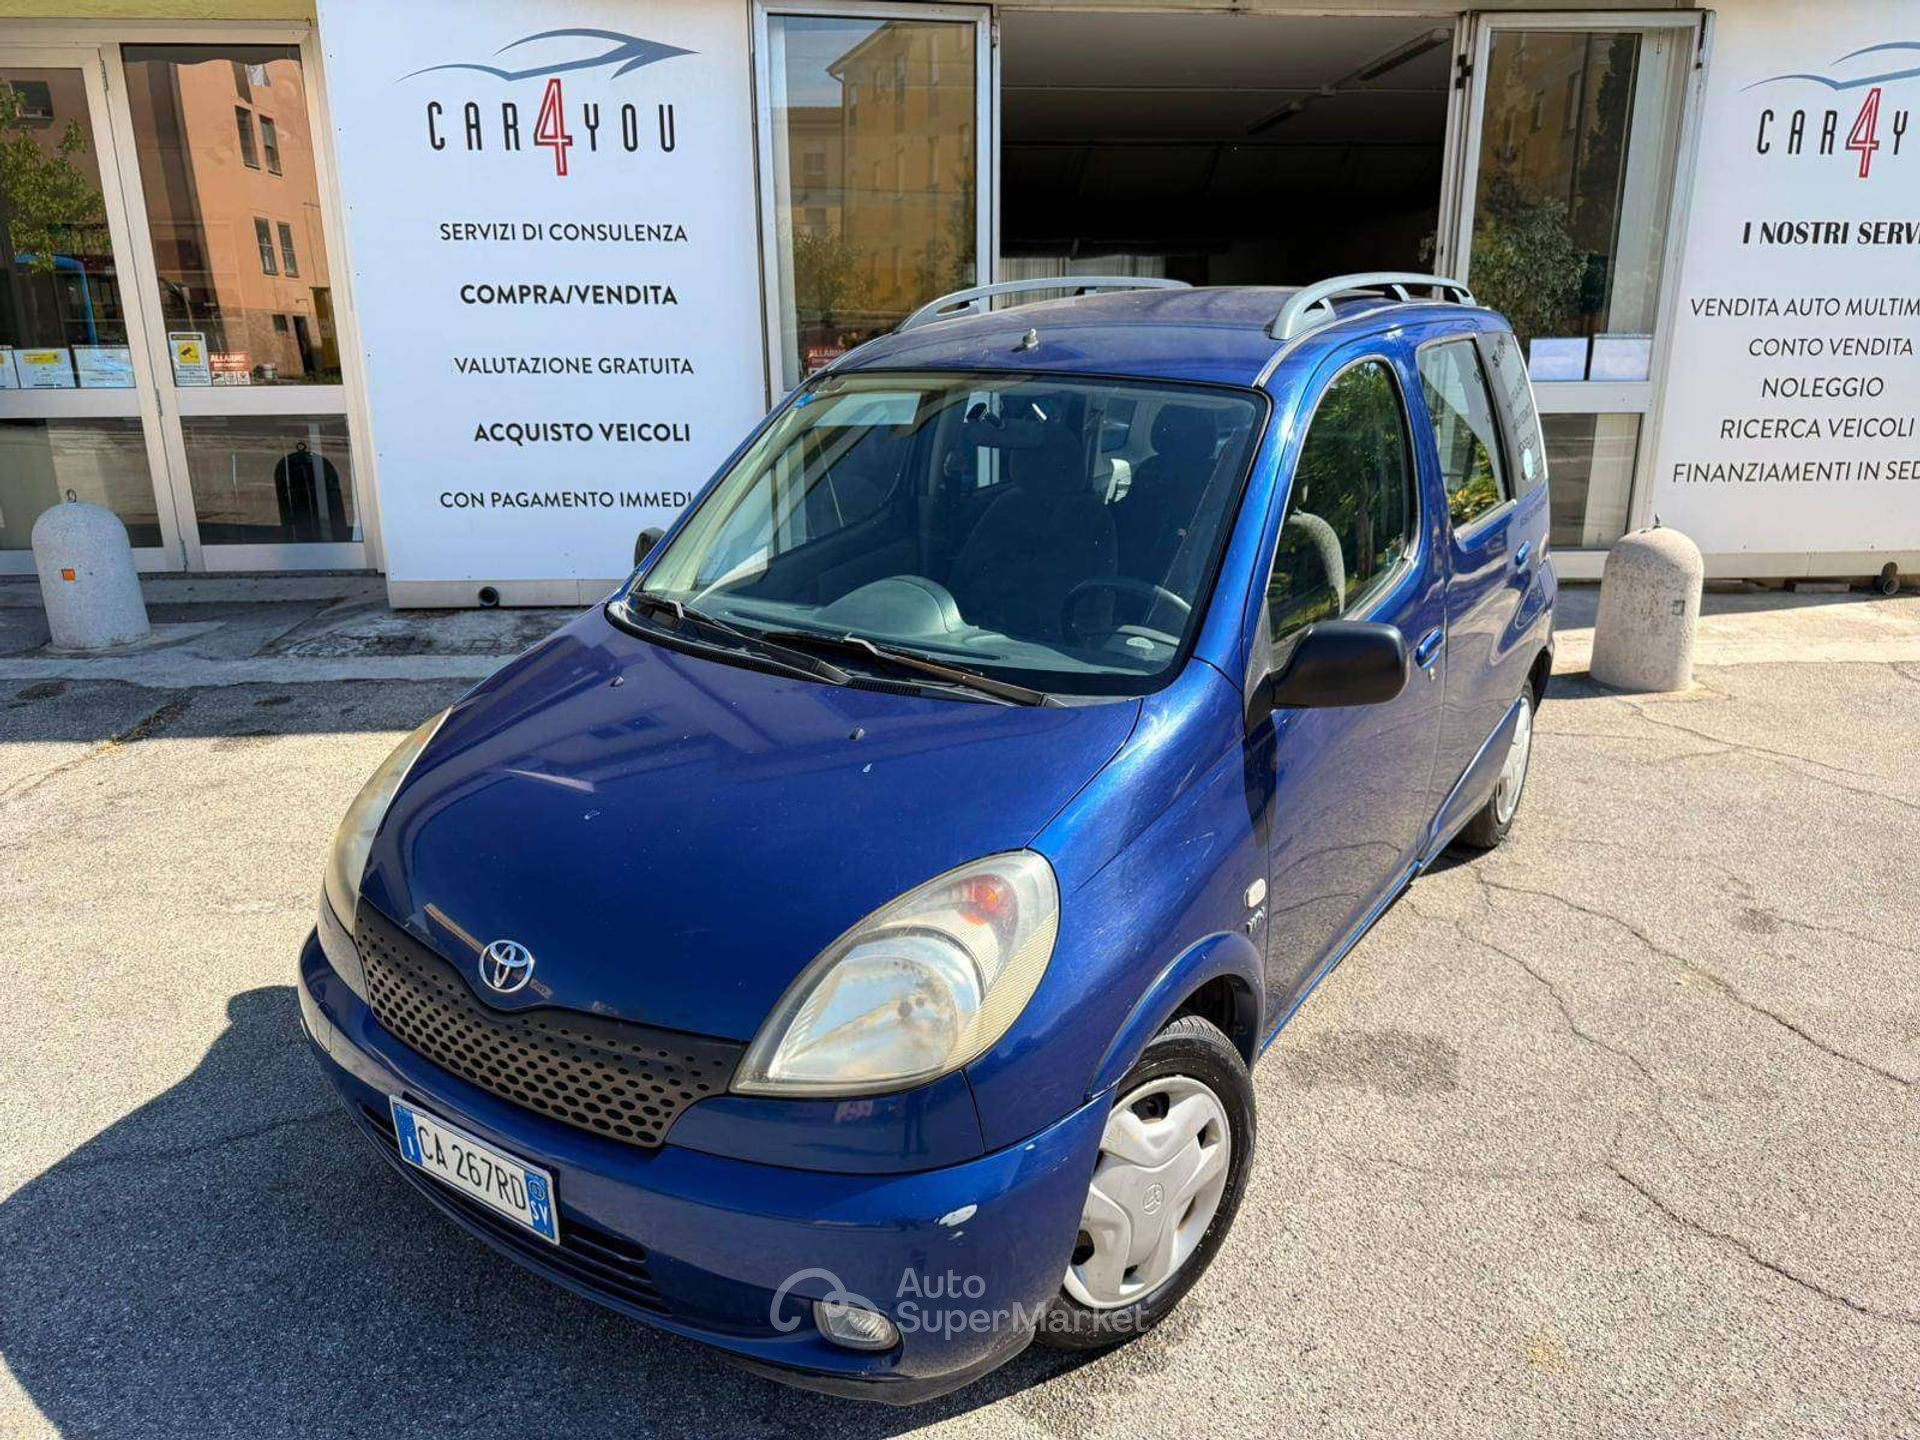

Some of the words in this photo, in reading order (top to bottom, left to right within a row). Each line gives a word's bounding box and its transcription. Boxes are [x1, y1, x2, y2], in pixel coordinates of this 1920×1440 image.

[440, 223, 516, 241] SERVIZI
[523, 223, 544, 241] DI
[549, 224, 688, 242] CONSULENZA
[1743, 222, 1752, 245] I
[1760, 221, 1850, 245] NOSTRI
[1857, 222, 1920, 245] SERV
[460, 284, 678, 305] COMPRA/VENDITA
[1690, 298, 1779, 317] VENDITA
[1783, 298, 1841, 317] AUTO
[1845, 297, 1920, 316] MULTIM
[1749, 338, 1824, 357] CONTO
[1830, 338, 1913, 357] VENDITA
[454, 357, 593, 375] VALUTAZIONE
[598, 357, 694, 375] GRATUITA
[1762, 377, 1884, 398] NOLEGGIO
[474, 423, 593, 446] ACQUISTO
[599, 423, 691, 442] VEICOLI
[1721, 419, 1822, 439] RICERCA
[1828, 418, 1914, 438] VEICOLI
[1673, 462, 1852, 483] FINANZIAMENTI
[1857, 461, 1880, 481] IN
[1886, 460, 1920, 481] SED
[440, 492, 485, 508] CON
[491, 492, 614, 508] PAGAMENTO
[419, 1127, 448, 1170] CA
[530, 1200, 548, 1226] SV
